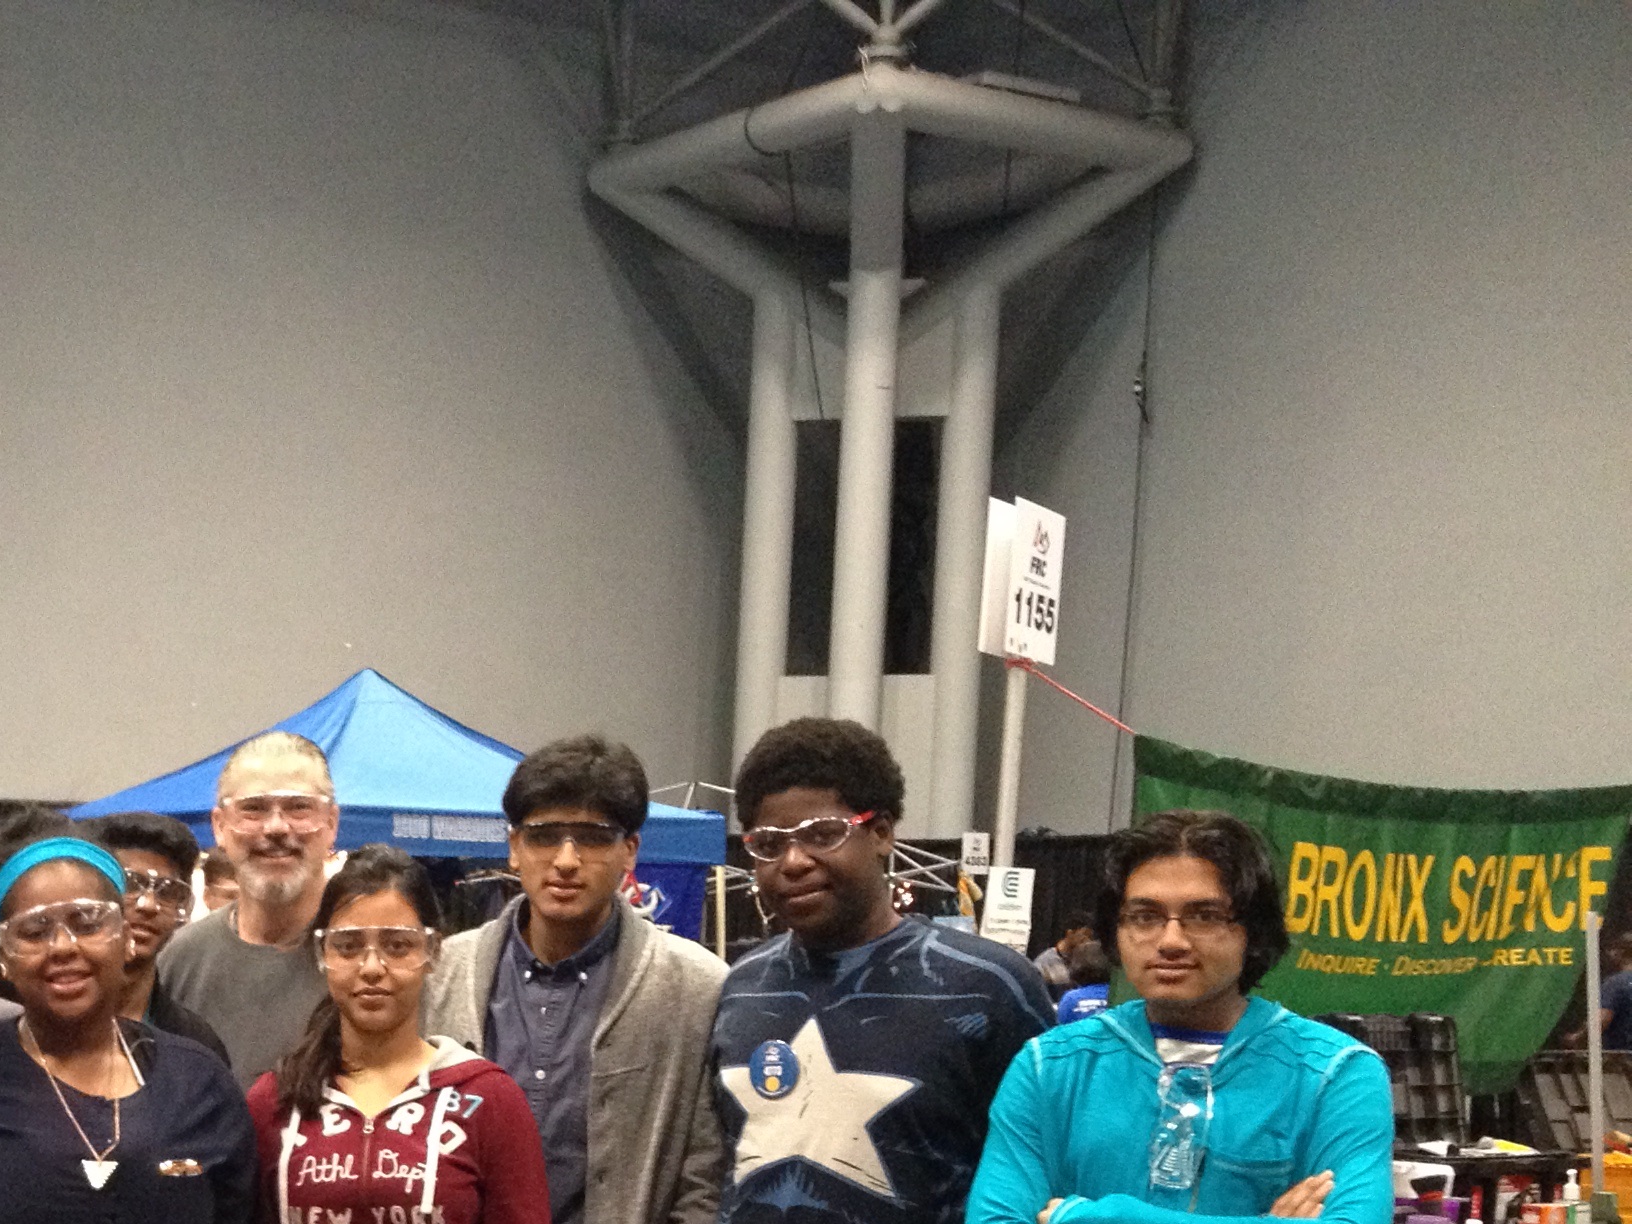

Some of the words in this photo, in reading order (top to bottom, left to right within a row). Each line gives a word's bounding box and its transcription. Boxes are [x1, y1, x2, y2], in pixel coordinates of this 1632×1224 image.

[1029, 556, 1047, 577] FRC
[1015, 588, 1055, 634] 1155
[1284, 841, 1435, 943] BRONX
[1296, 949, 1381, 976] INQUIRE
[1481, 947, 1574, 967] REATE
[296, 1153, 358, 1187] Athl
